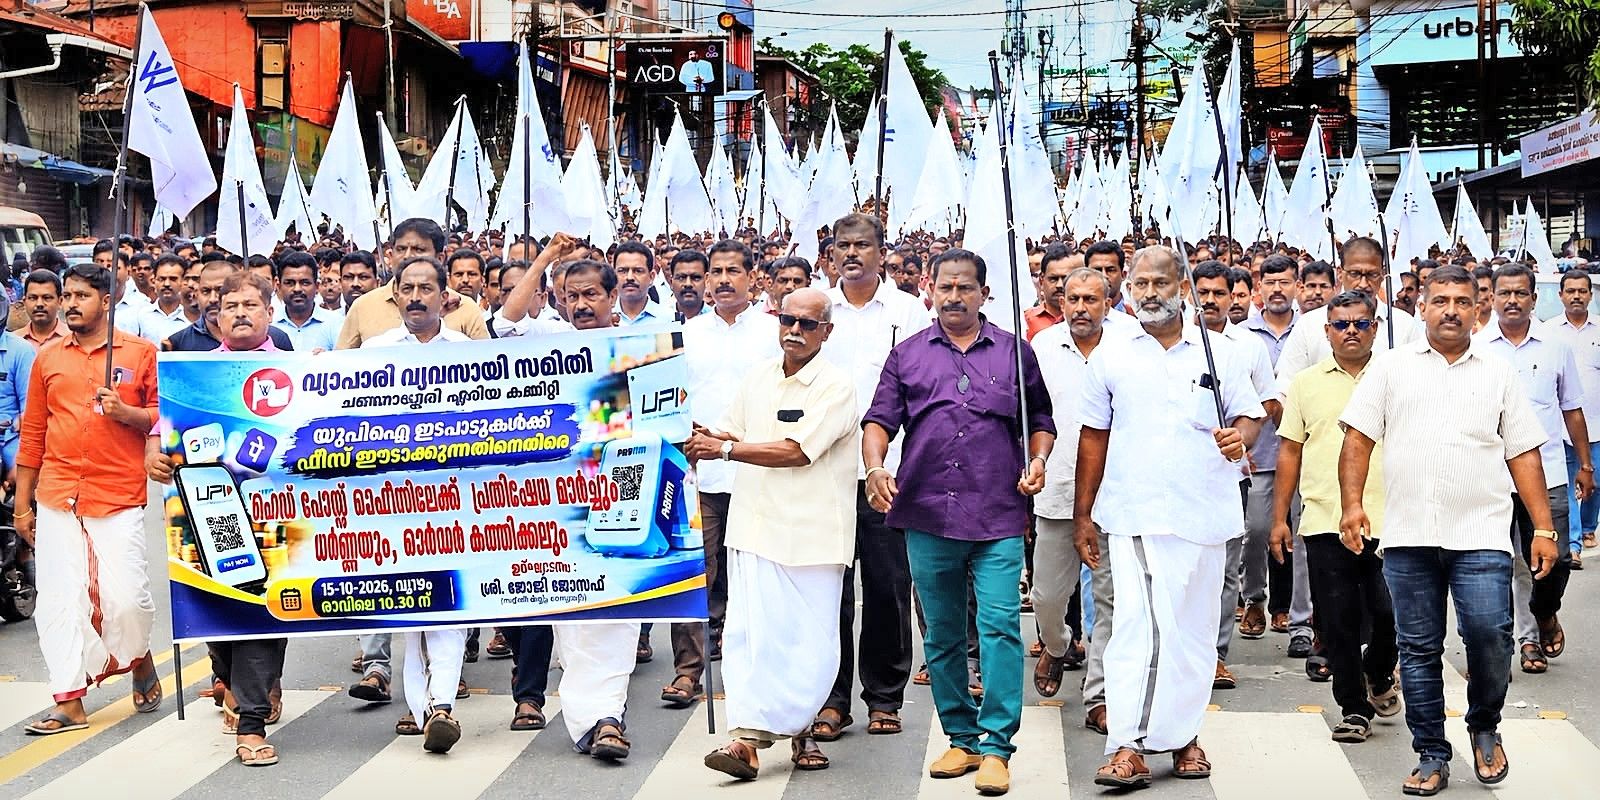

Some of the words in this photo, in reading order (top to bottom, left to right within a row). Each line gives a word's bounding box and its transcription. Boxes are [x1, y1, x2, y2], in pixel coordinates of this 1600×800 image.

[634, 65, 676, 82] AGD
[302, 363, 395, 396] വ്യാപാരി
[401, 354, 509, 391] വ്യവസായി
[515, 347, 593, 379] സമിതി
[641, 387, 679, 414] UPI
[313, 420, 410, 448] യുപിഐ
[414, 409, 553, 441] ഇടപാടുകൾക്ക്
[297, 445, 352, 472] ഫീസ്
[355, 433, 569, 469] ഈടാക്കുന്നതിനെതിരെ
[196, 484, 227, 501] UPI
[471, 473, 551, 514] പ്രതിഷേധ
[556, 470, 619, 511] മാർച്ചും
[321, 580, 393, 597] 15-10-2026,
[321, 597, 375, 613] രാവിലെ
[378, 595, 415, 610] 10.30
[418, 591, 432, 608] ന്
